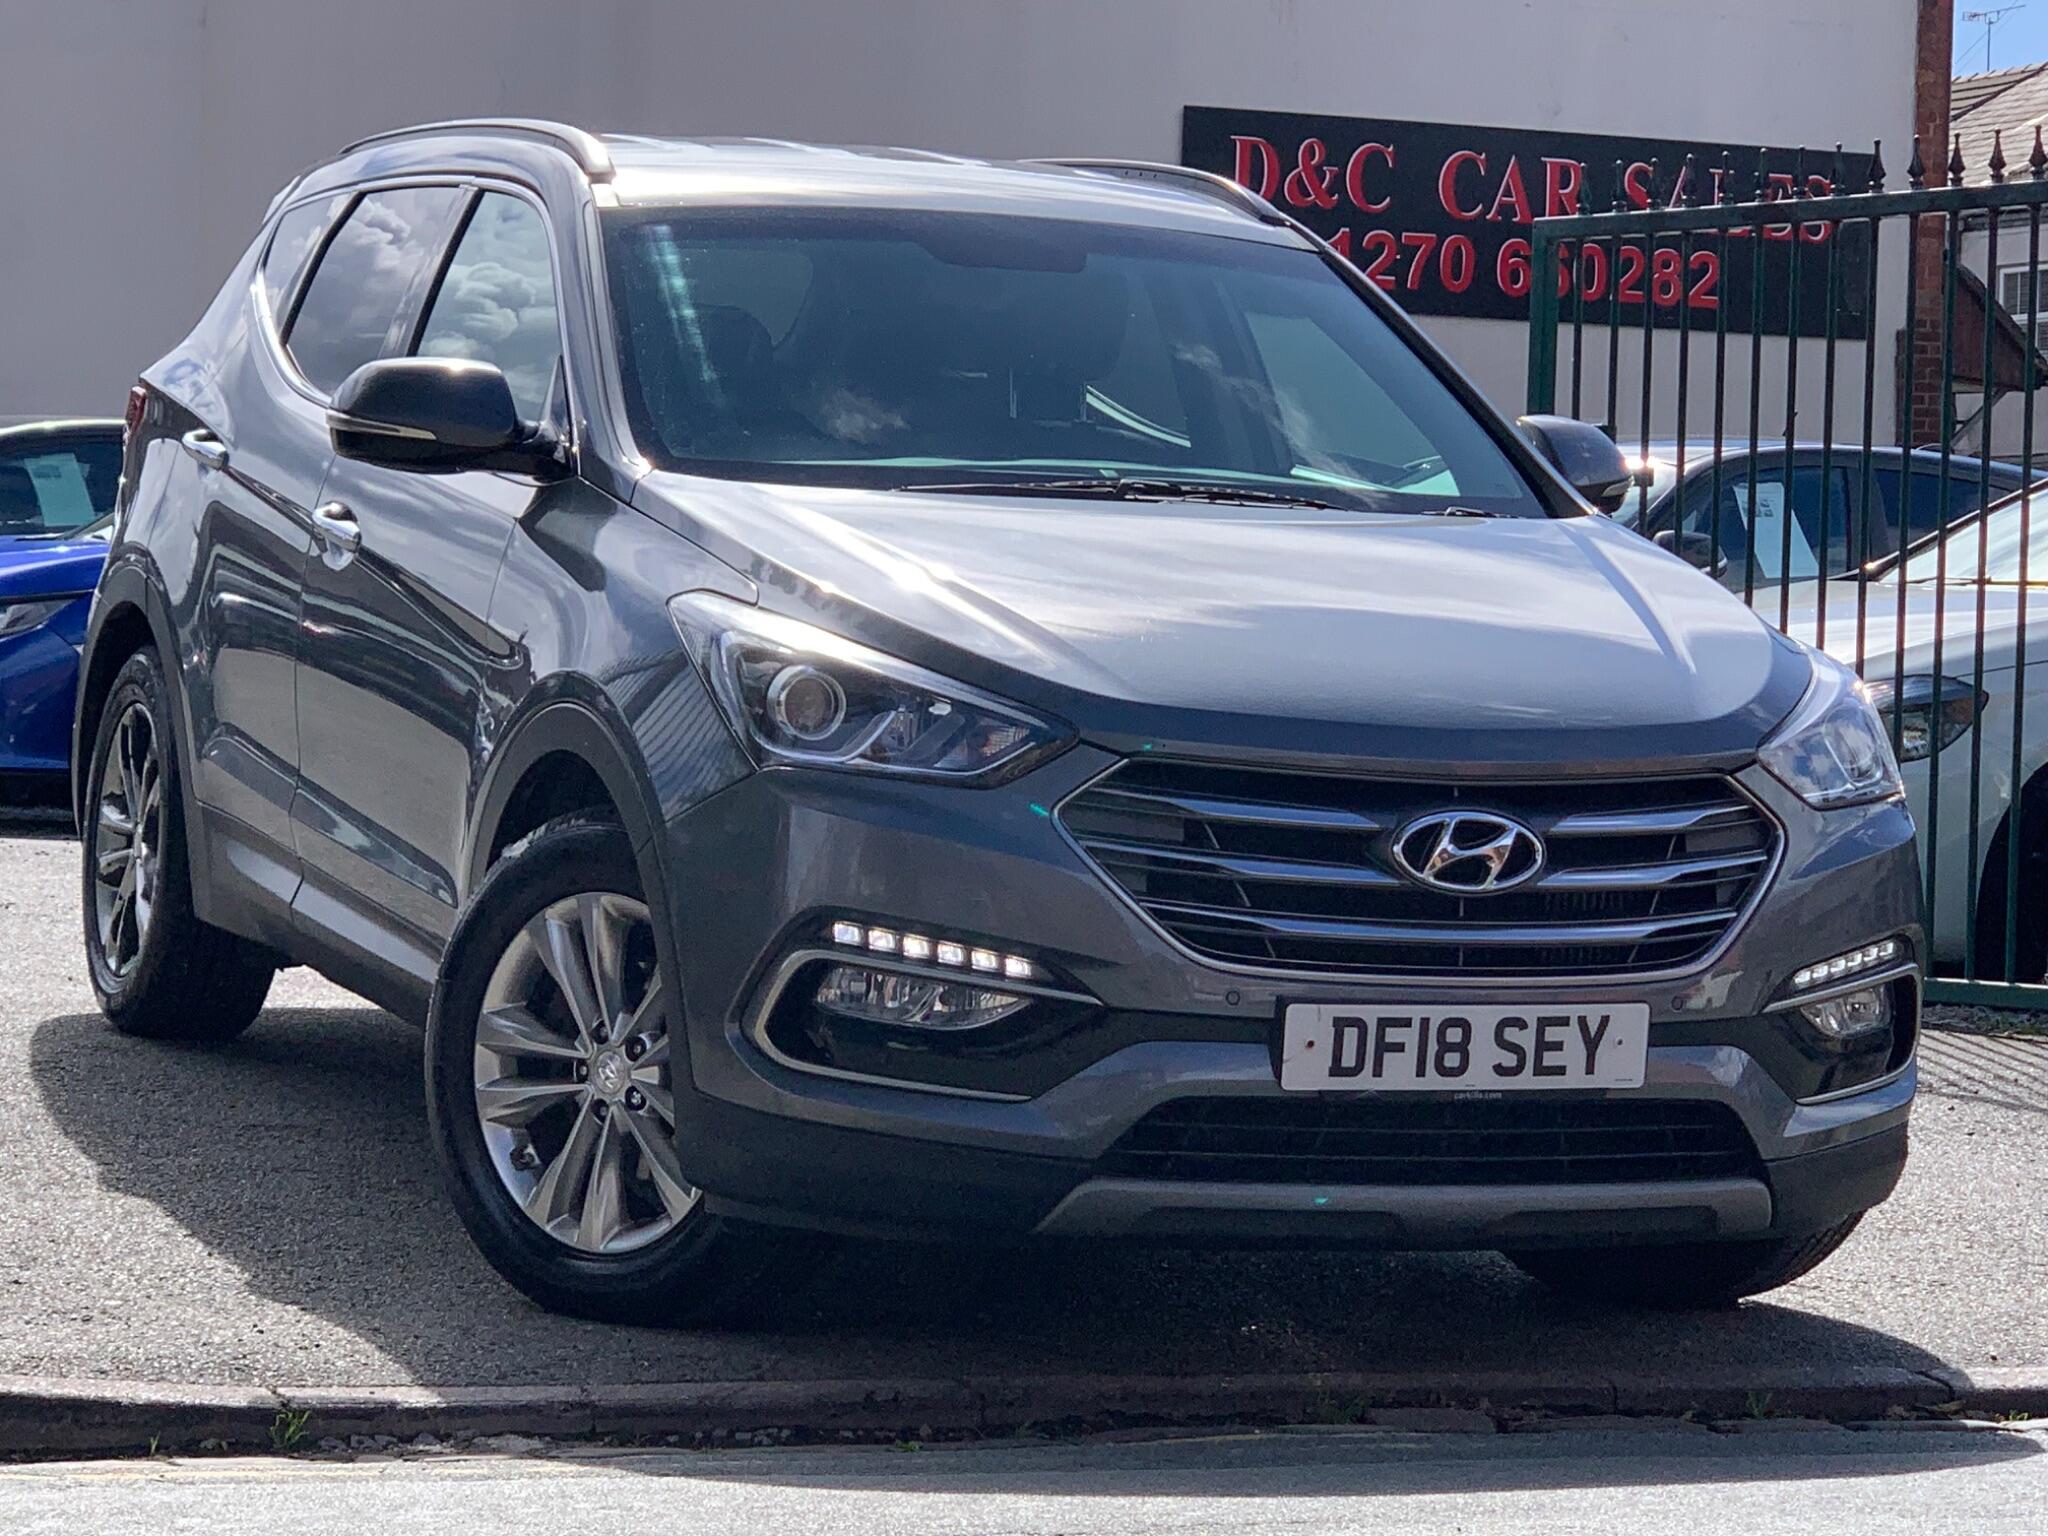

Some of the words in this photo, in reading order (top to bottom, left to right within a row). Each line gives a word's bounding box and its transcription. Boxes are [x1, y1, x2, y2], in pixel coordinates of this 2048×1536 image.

[1230, 135, 1396, 213] D&C
[1438, 150, 1581, 225] CAR
[1328, 1016, 1472, 1079] DF18
[1491, 1014, 1611, 1078] SEY
